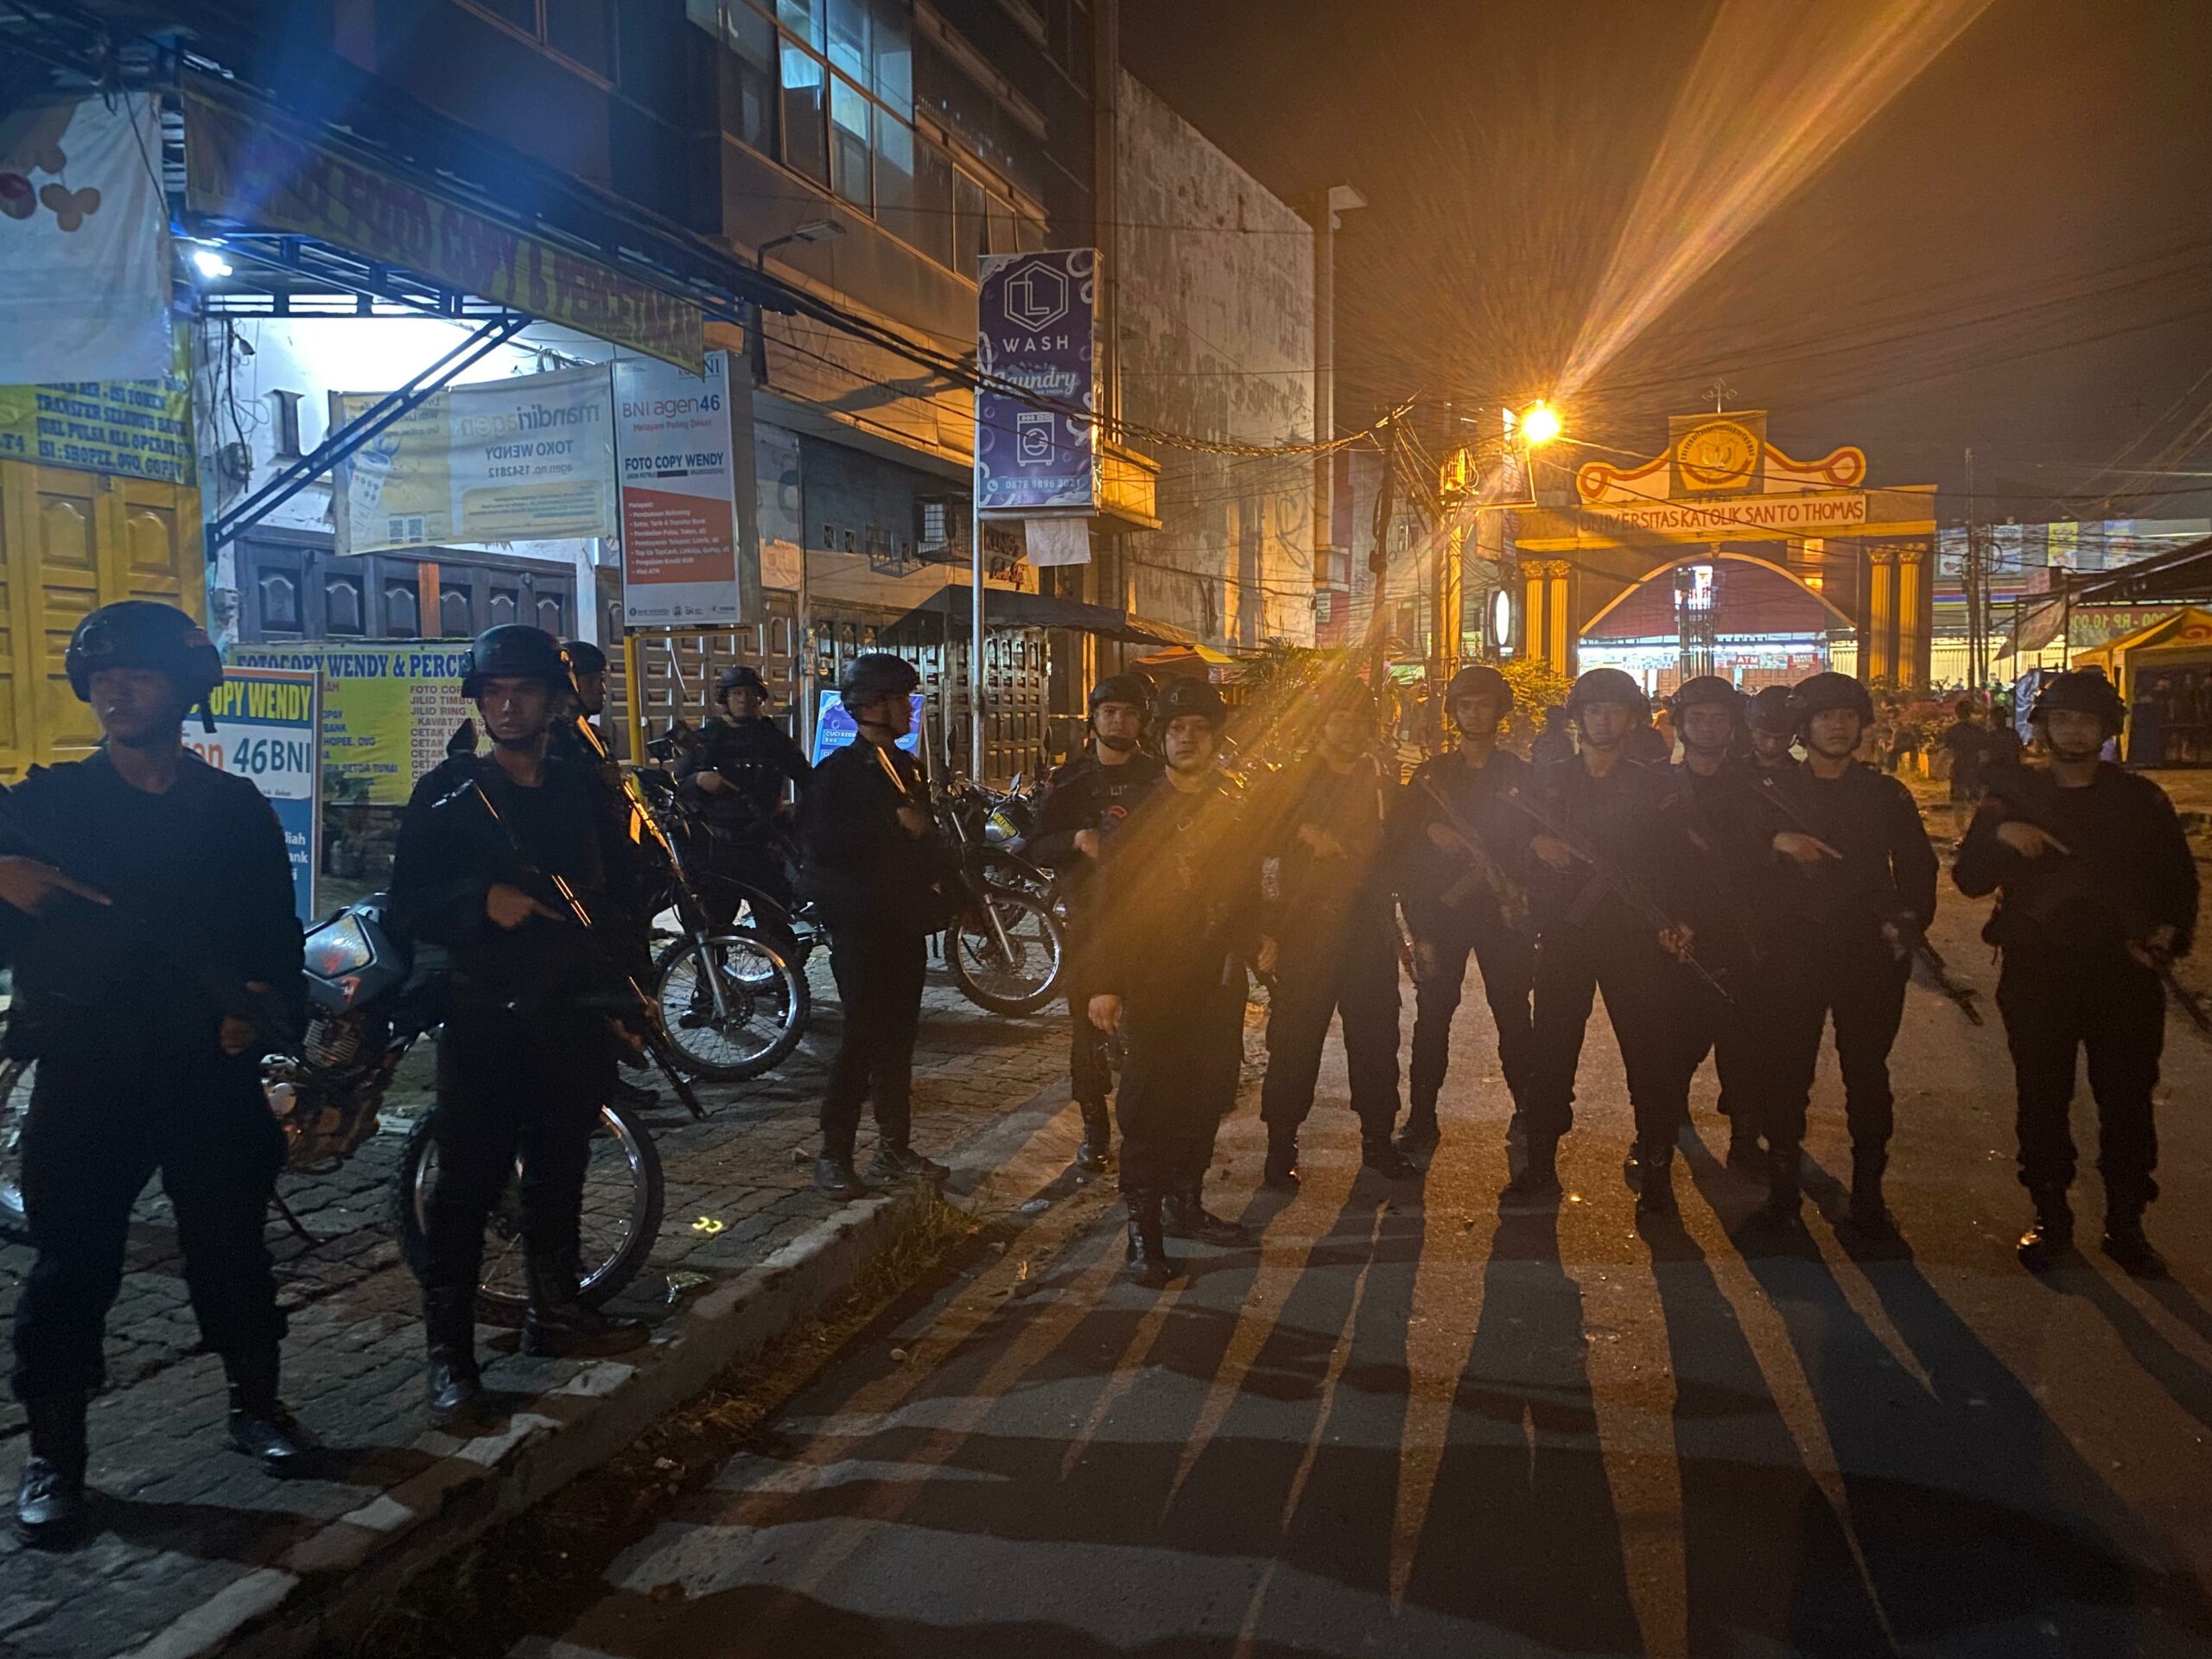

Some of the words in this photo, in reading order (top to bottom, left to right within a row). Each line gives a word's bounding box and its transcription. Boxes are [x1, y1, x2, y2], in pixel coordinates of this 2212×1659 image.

[441, 205, 518, 302] COPY
[1002, 334, 1069, 353] WASH
[35, 394, 101, 421] TRANSFER
[622, 401, 650, 417] BNI
[654, 394, 721, 418] agen46
[67, 422, 105, 443] PULSA
[625, 457, 652, 470] FOTO
[655, 454, 683, 468] COPY
[686, 452, 724, 467] WENDY
[1006, 480, 1028, 489] 0878
[1580, 510, 1680, 532] UNIVERSITAS
[1681, 507, 1741, 528] KATOLIK
[1745, 504, 1799, 524] SANTO
[1802, 500, 1864, 520] THOMAS
[327, 654, 388, 677] WENDY
[393, 654, 406, 677] &
[410, 685, 437, 694] FOTO
[248, 682, 312, 721] WENDY
[410, 696, 436, 705] JILID
[410, 707, 436, 715] JILID
[440, 707, 467, 715] RING
[410, 728, 444, 737] CETAK
[410, 739, 444, 747] CETAK
[411, 749, 444, 758] CETAK
